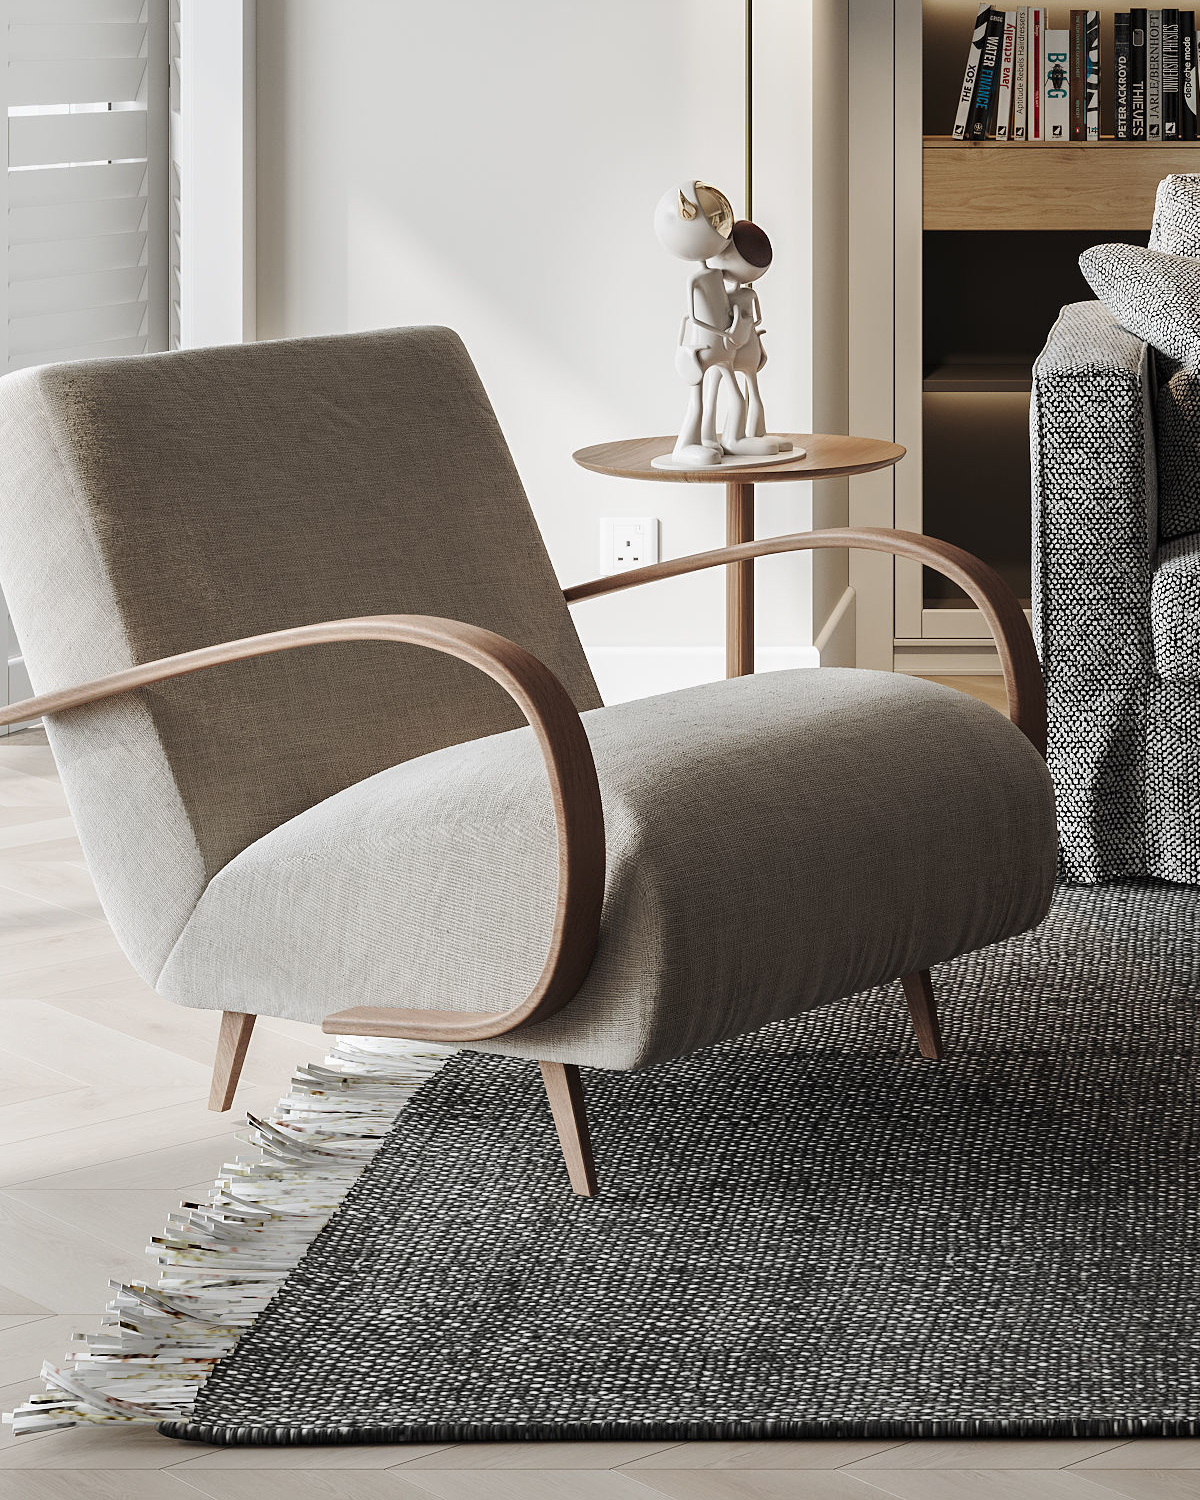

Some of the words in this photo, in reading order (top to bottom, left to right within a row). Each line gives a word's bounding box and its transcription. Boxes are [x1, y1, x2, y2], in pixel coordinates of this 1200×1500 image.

[982, 36, 1000, 67] WATER
[1002, 22, 1015, 63] actually
[1163, 24, 1178, 52] PHYSICS
[964, 64, 976, 84] SOX
[976, 68, 993, 110] FINANCE
[1000, 67, 1011, 89] Java
[1118, 56, 1127, 104] ACKROYD
[1163, 54, 1178, 93] UNIVERSITY
[962, 85, 972, 103] THE
[1132, 80, 1144, 136] THIEVES
[1118, 106, 1127, 138] PETER
